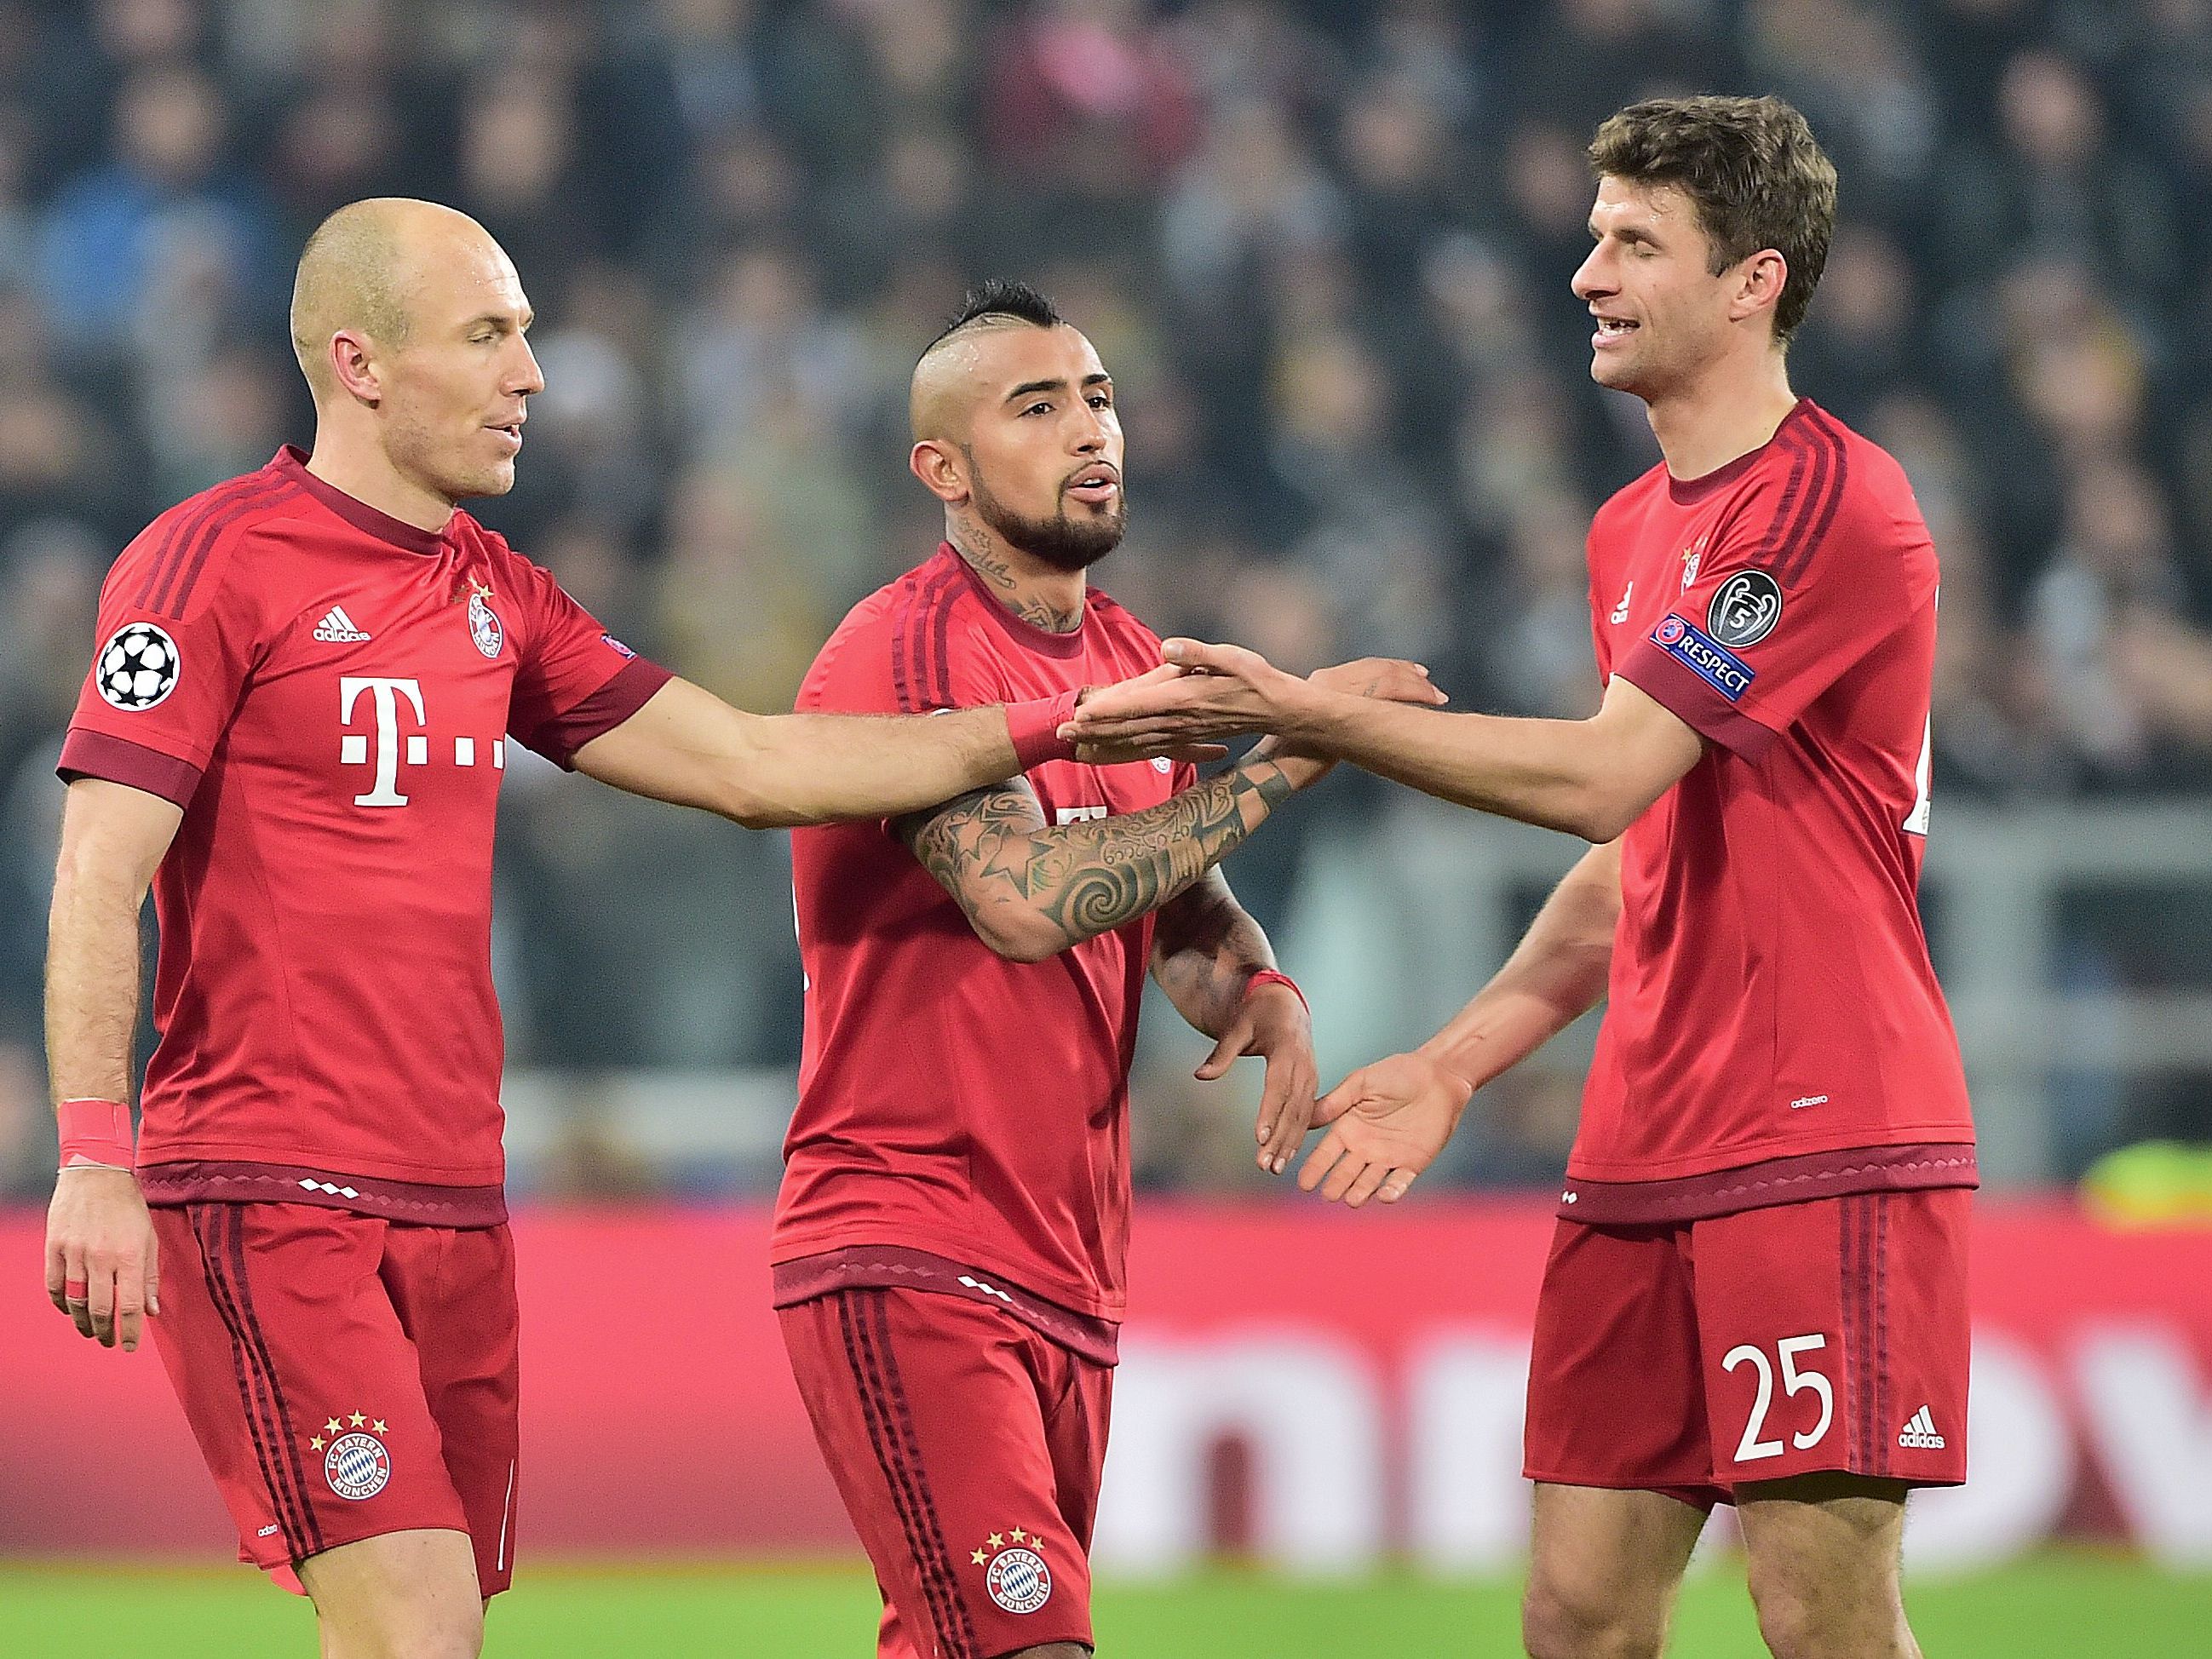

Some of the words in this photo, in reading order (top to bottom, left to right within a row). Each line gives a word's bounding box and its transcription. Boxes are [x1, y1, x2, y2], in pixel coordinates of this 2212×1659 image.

[1729, 606, 1751, 629] 5
[313, 627, 371, 643] adidas
[1678, 635, 1750, 692] RESPECT
[1721, 1333, 1834, 1463] 25
[336, 1436, 383, 1459] BAYERN
[1898, 1432, 1945, 1449] adidas
[997, 1552, 1044, 1574] BAYERN
